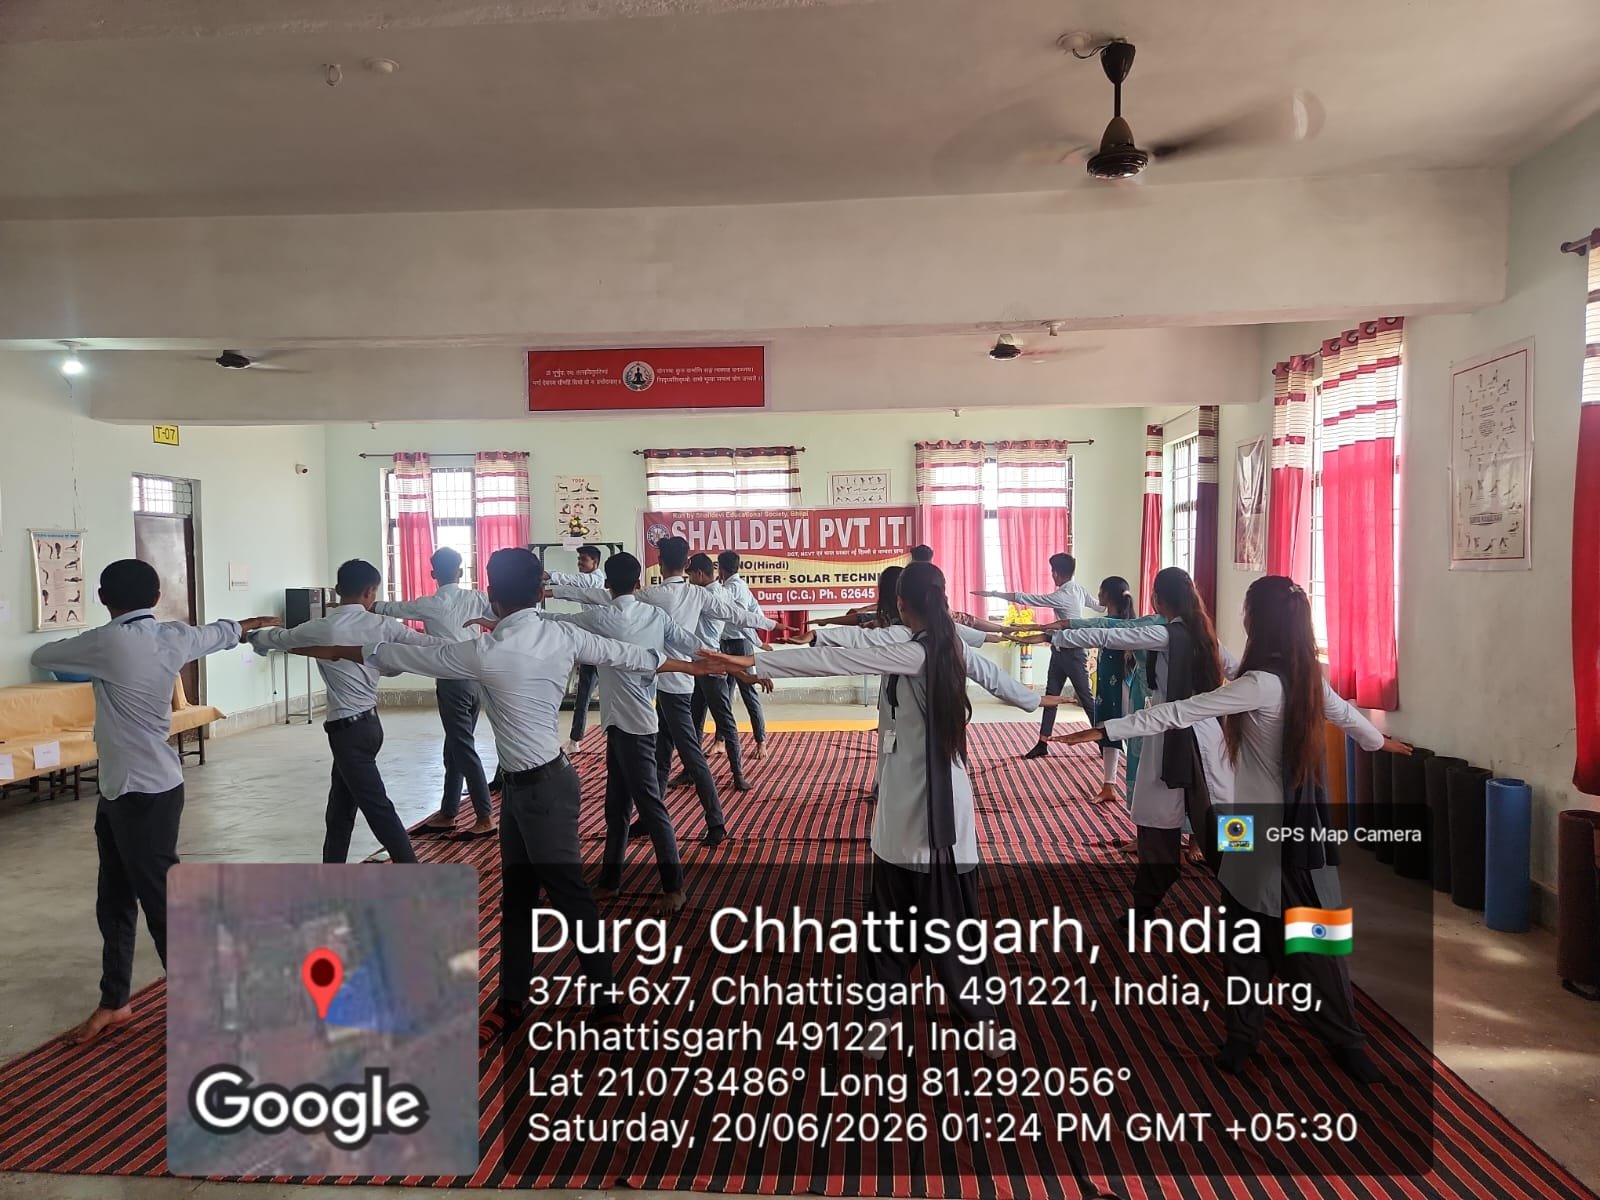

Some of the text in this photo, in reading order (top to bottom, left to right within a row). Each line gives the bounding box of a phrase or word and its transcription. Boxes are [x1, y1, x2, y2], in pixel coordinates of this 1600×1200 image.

[155, 427, 175, 440] T-07
[671, 519, 810, 551] SHAILDEVI
[819, 517, 871, 549] PVT
[880, 516, 912, 547] ITI
[789, 574, 830, 583] SOLAR
[758, 590, 783, 602] Durg
[787, 590, 816, 602] (C.G.)
[820, 588, 838, 600] Ph.
